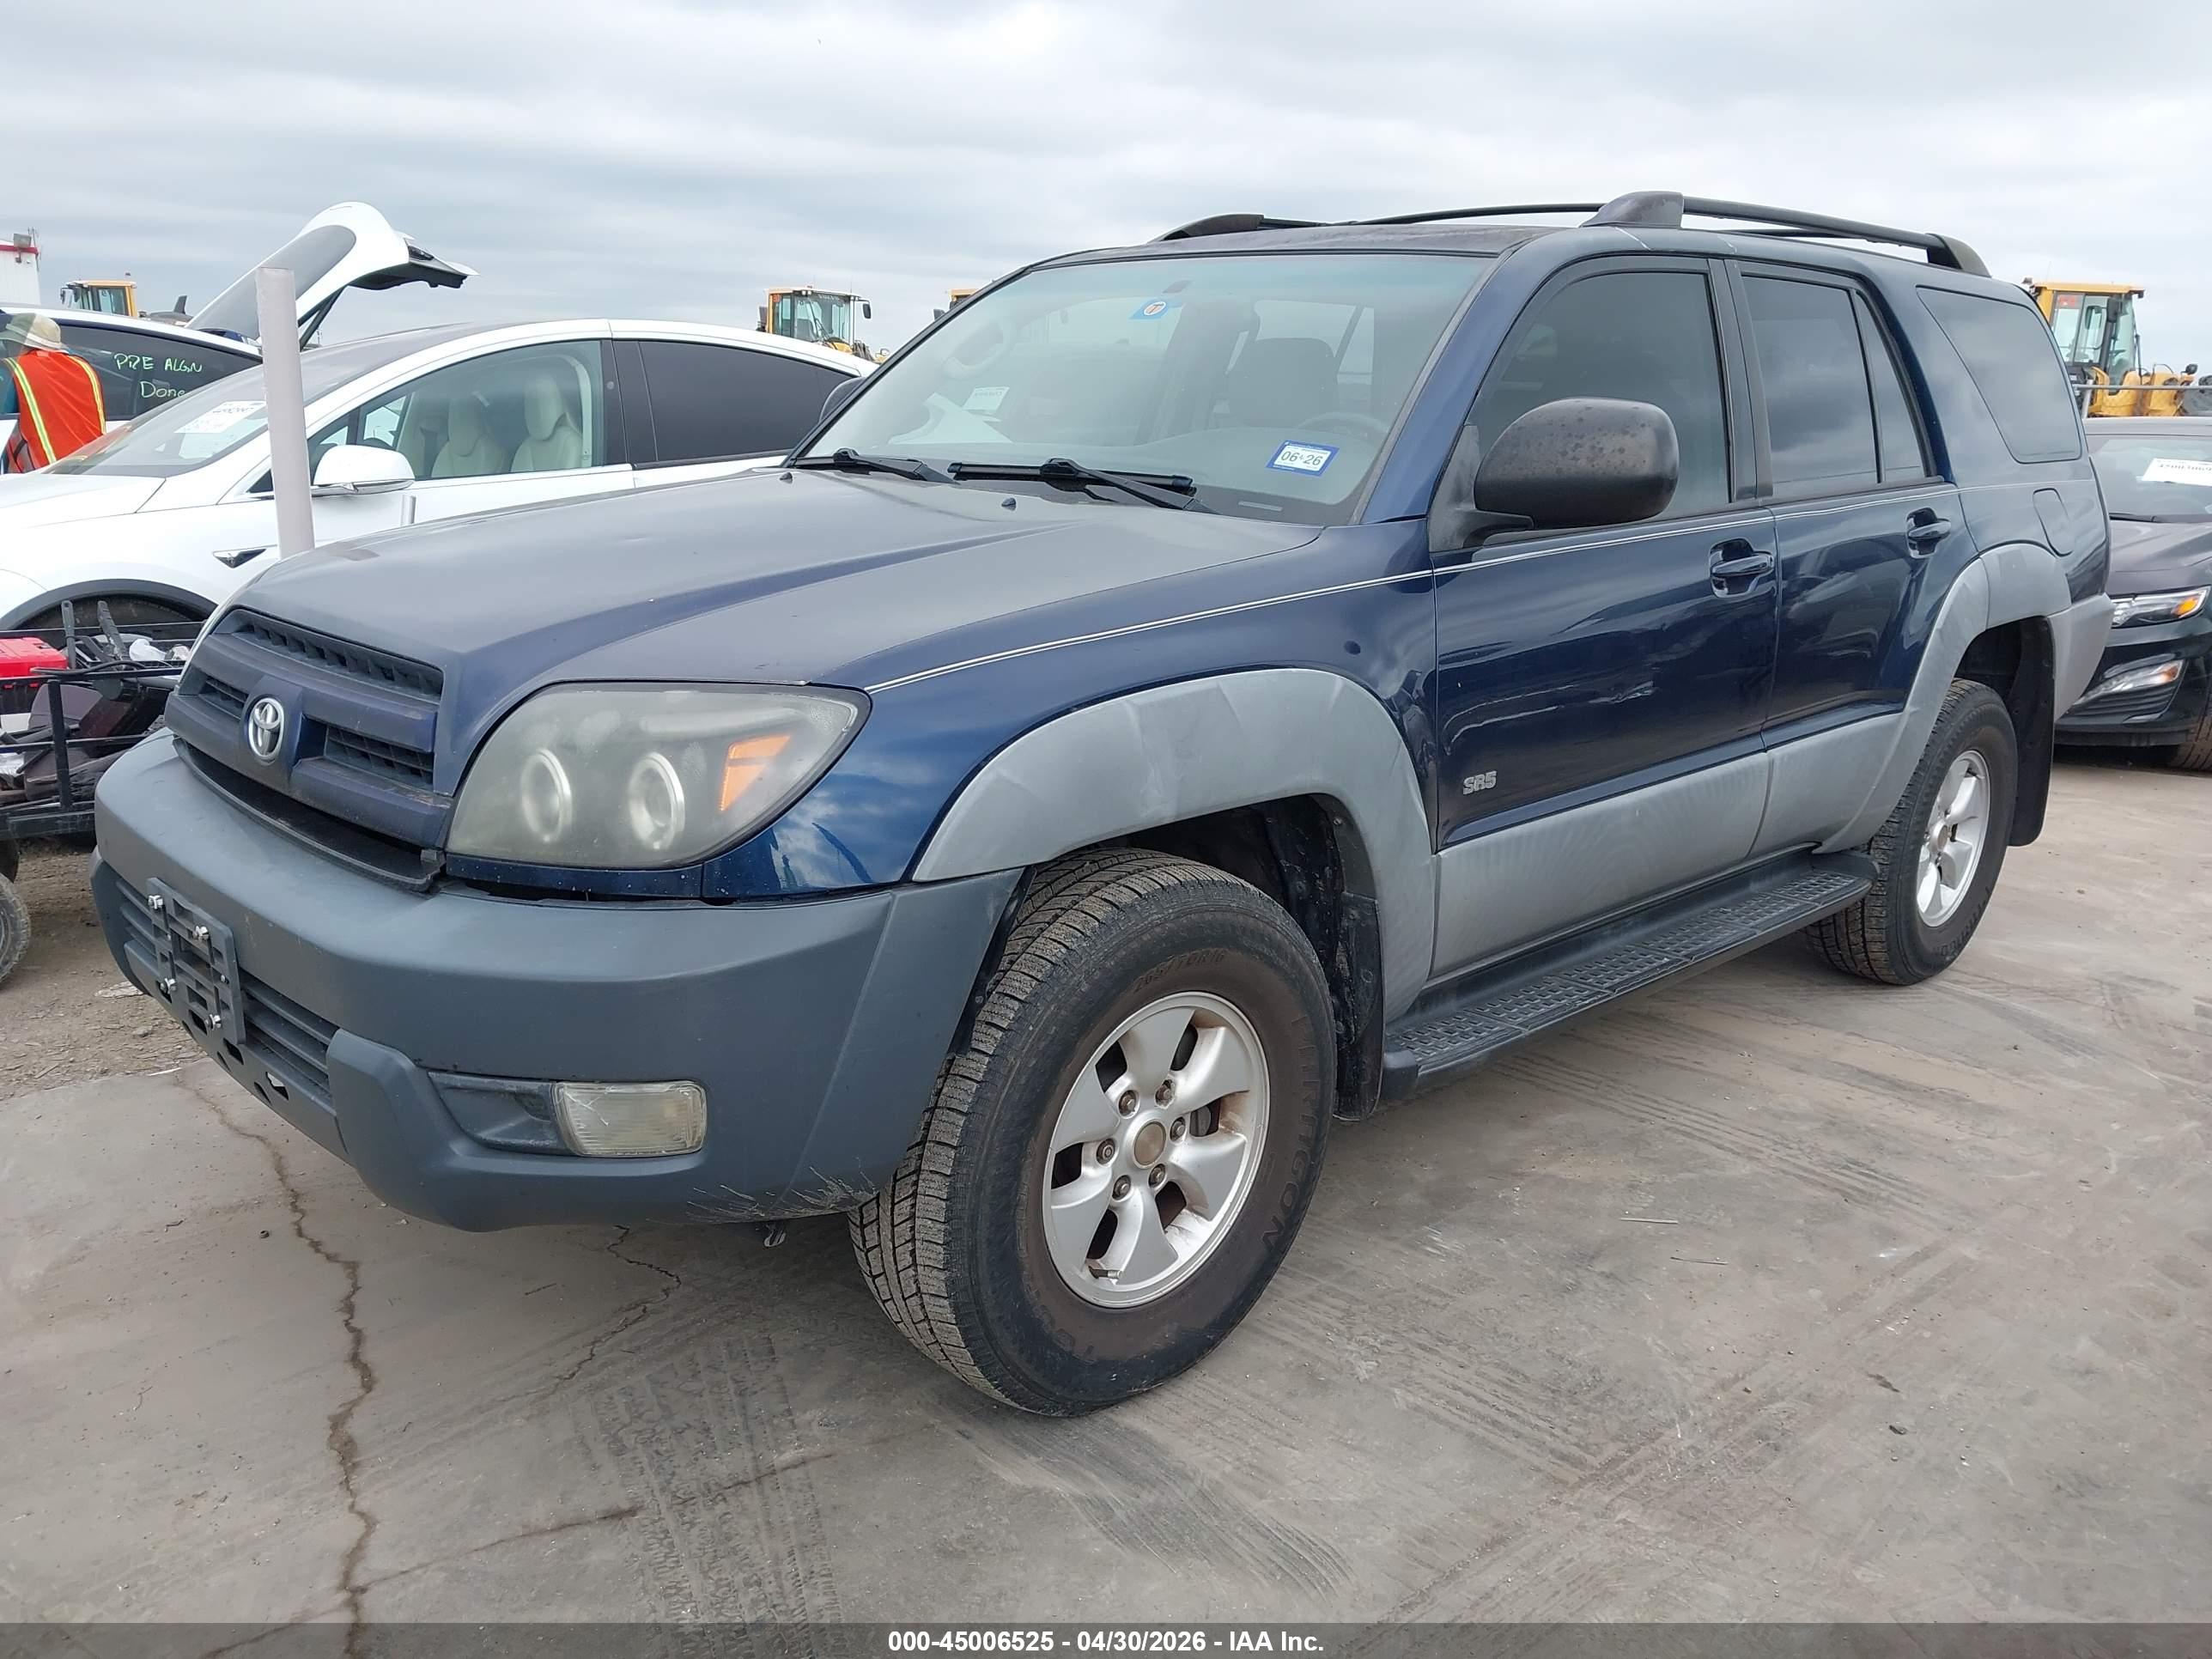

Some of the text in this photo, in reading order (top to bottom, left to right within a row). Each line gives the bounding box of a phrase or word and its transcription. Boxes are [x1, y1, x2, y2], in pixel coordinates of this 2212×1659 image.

[114, 353, 154, 370] PRE
[140, 380, 185, 398] Done
[1462, 770, 1498, 795] SR5
